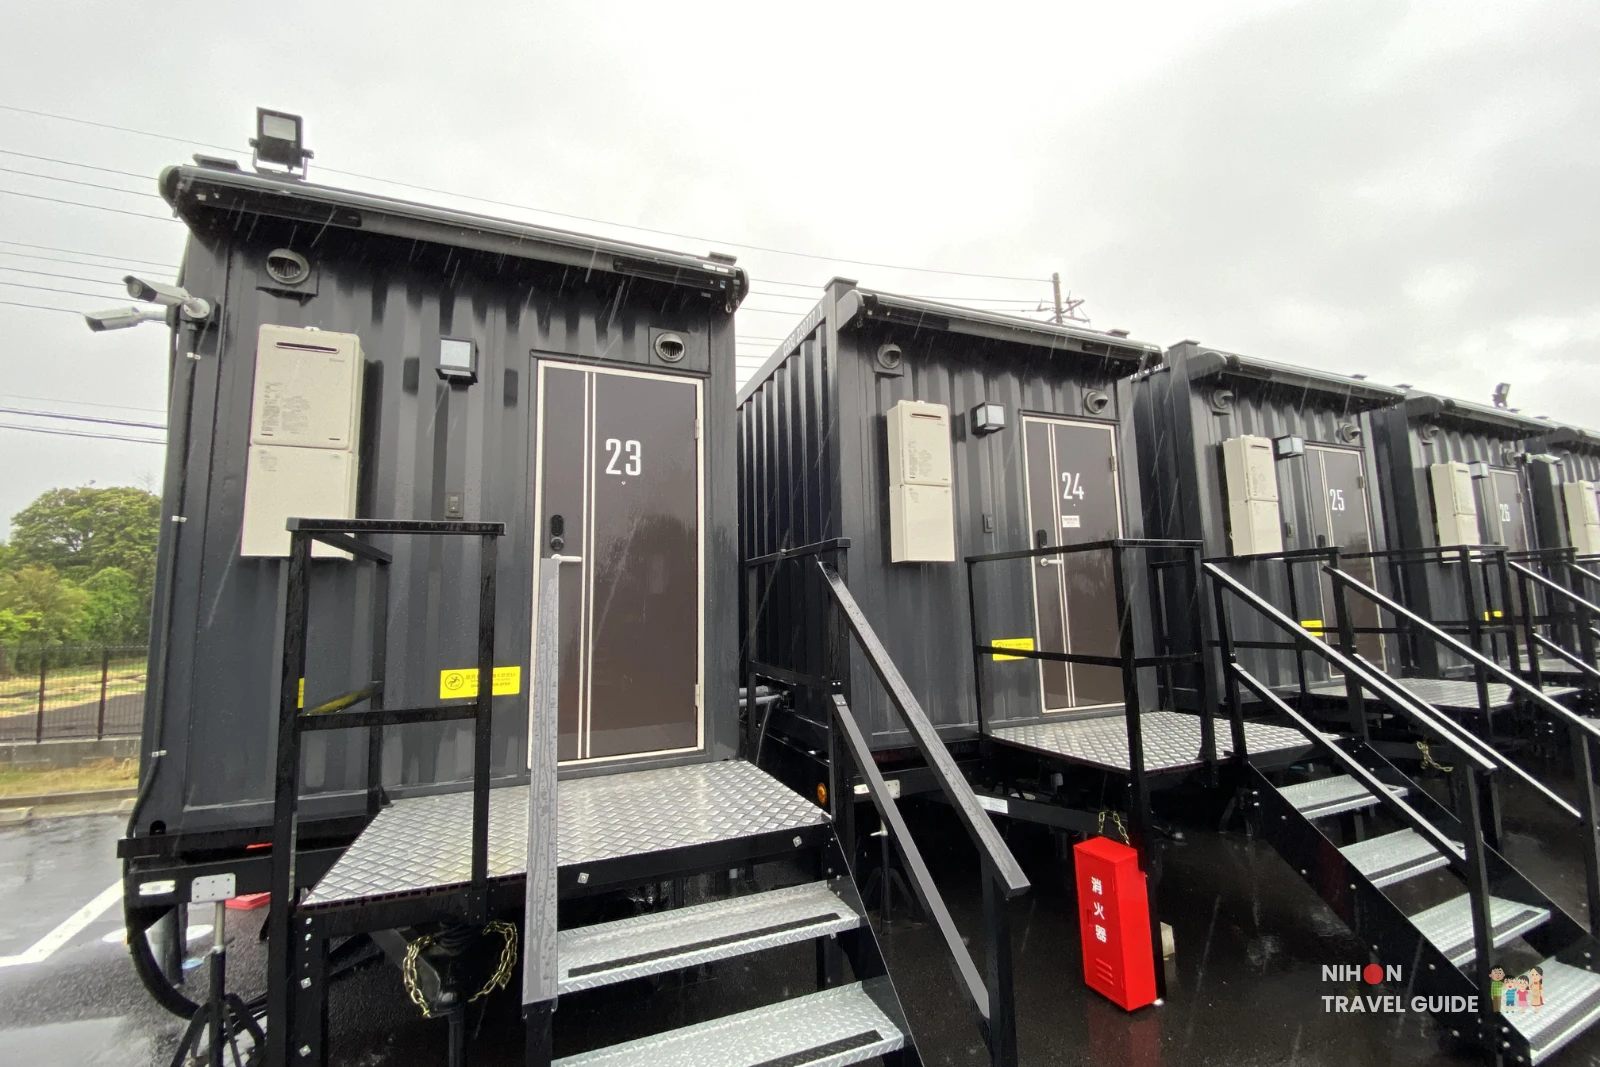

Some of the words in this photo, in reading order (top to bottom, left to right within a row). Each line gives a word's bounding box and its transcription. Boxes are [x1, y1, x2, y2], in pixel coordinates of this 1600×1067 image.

[605, 438, 641, 476] 23
[1061, 471, 1085, 500] 24
[1329, 489, 1345, 511] 25
[1499, 503, 1511, 522] 26
[1091, 876, 1107, 944] 消火器
